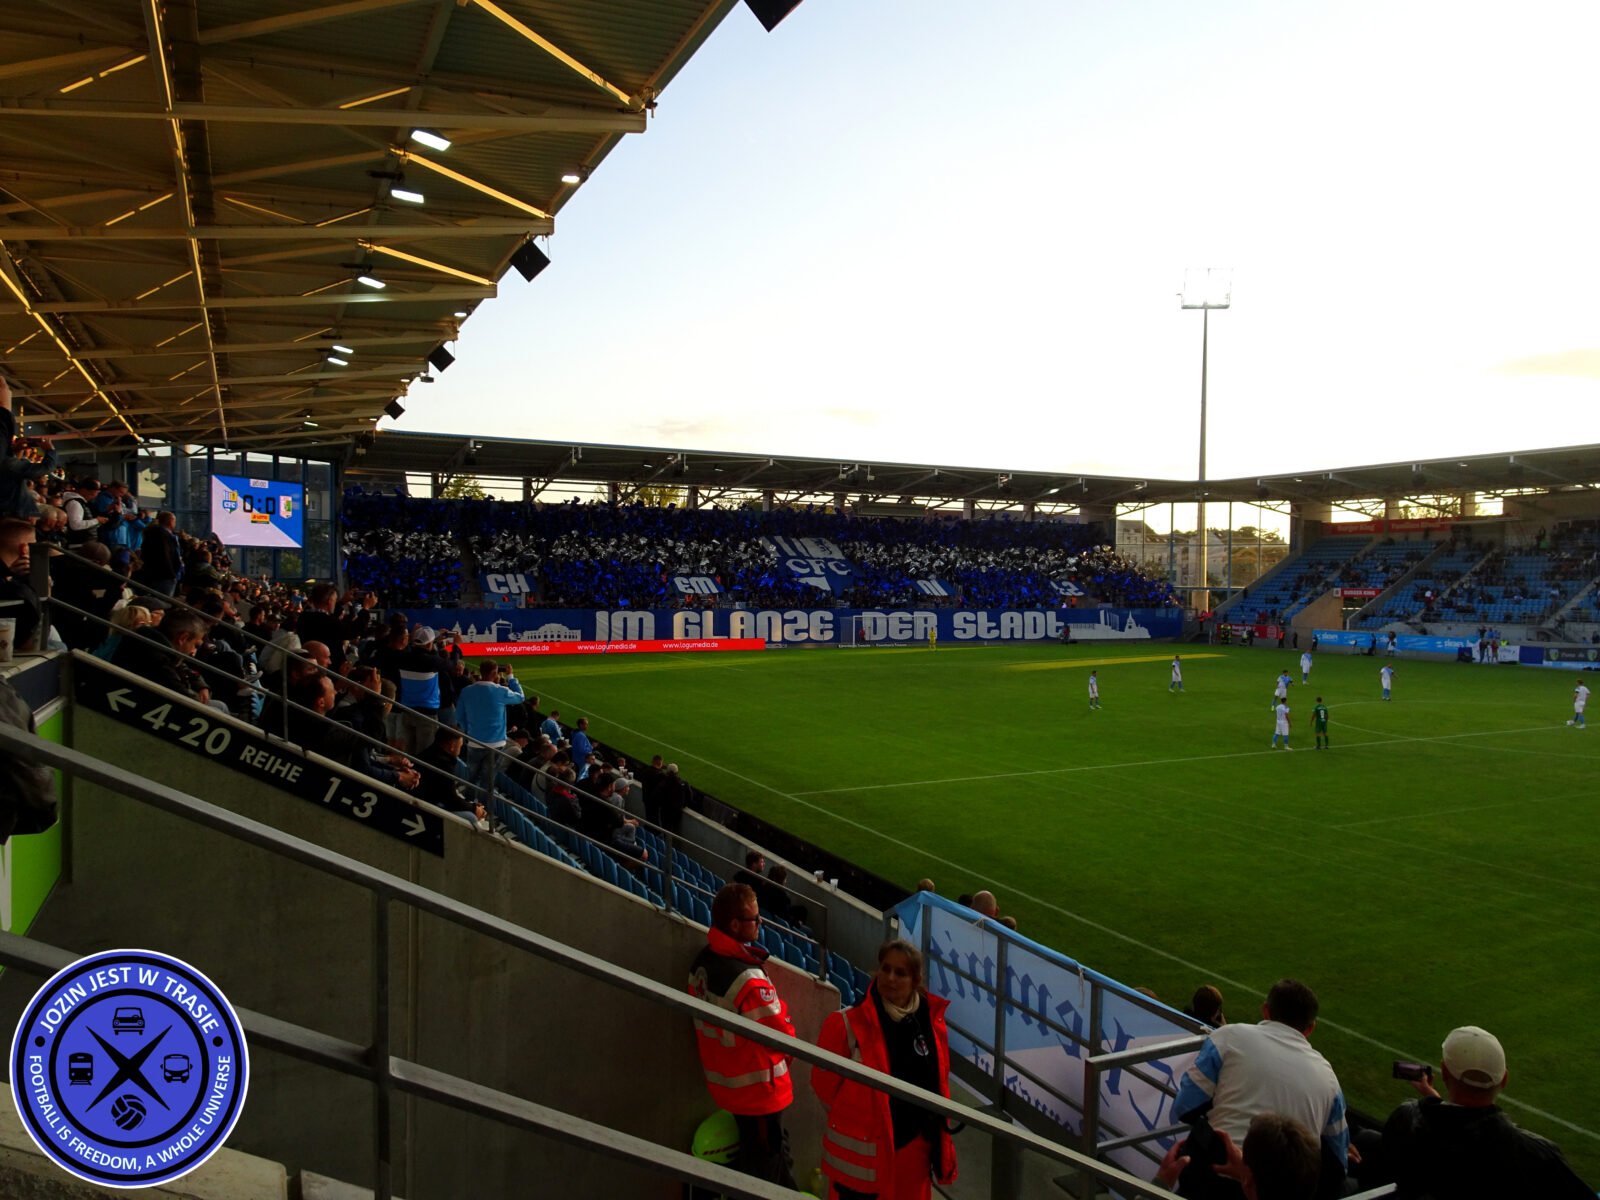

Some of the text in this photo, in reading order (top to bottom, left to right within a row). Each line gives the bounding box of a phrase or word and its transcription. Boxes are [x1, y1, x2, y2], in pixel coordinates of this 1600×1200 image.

[785, 558, 851, 575] CFC
[486, 573, 531, 594] CH
[595, 610, 656, 641] IM
[861, 611, 938, 641] DER
[141, 702, 378, 819] 4-20 REIHE 1-3
